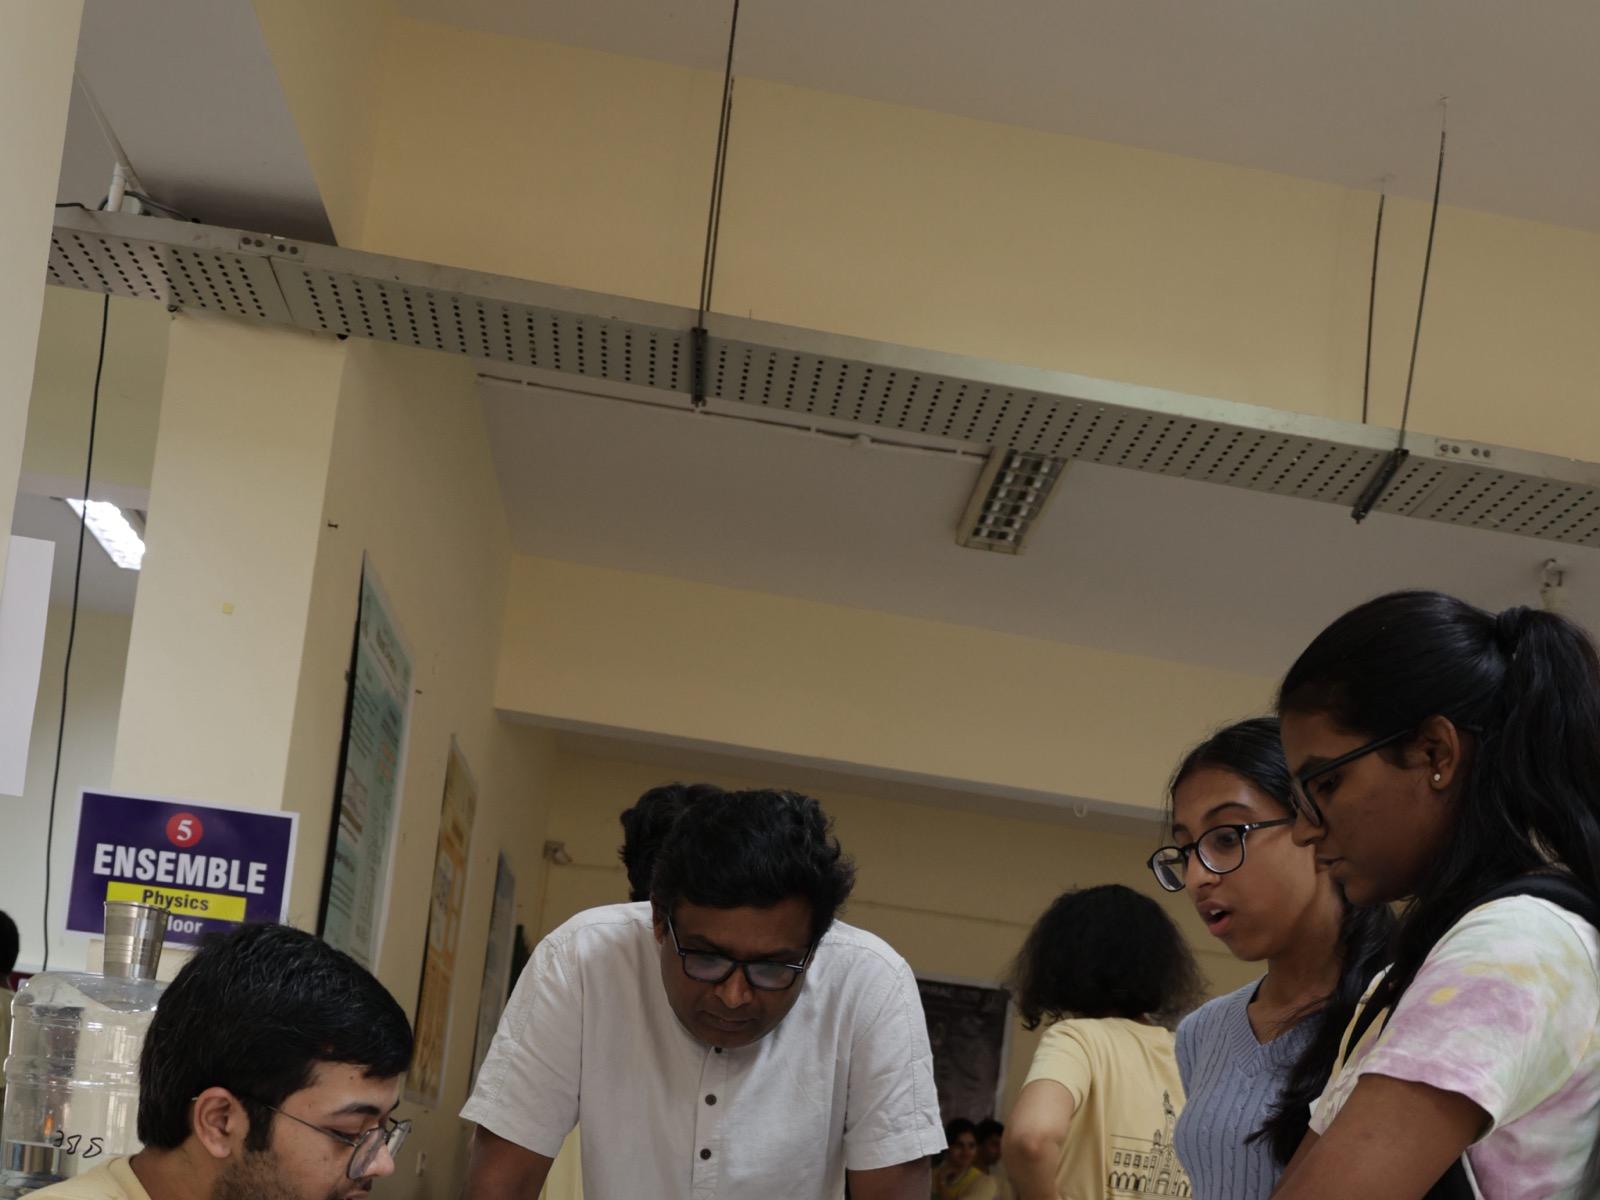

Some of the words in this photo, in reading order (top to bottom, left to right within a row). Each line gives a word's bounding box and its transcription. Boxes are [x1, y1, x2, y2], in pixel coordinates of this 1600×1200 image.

[176, 819, 193, 841] 5
[93, 842, 267, 894] ENSEMBLE
[143, 889, 209, 911] Physics
[166, 915, 203, 934] loor
